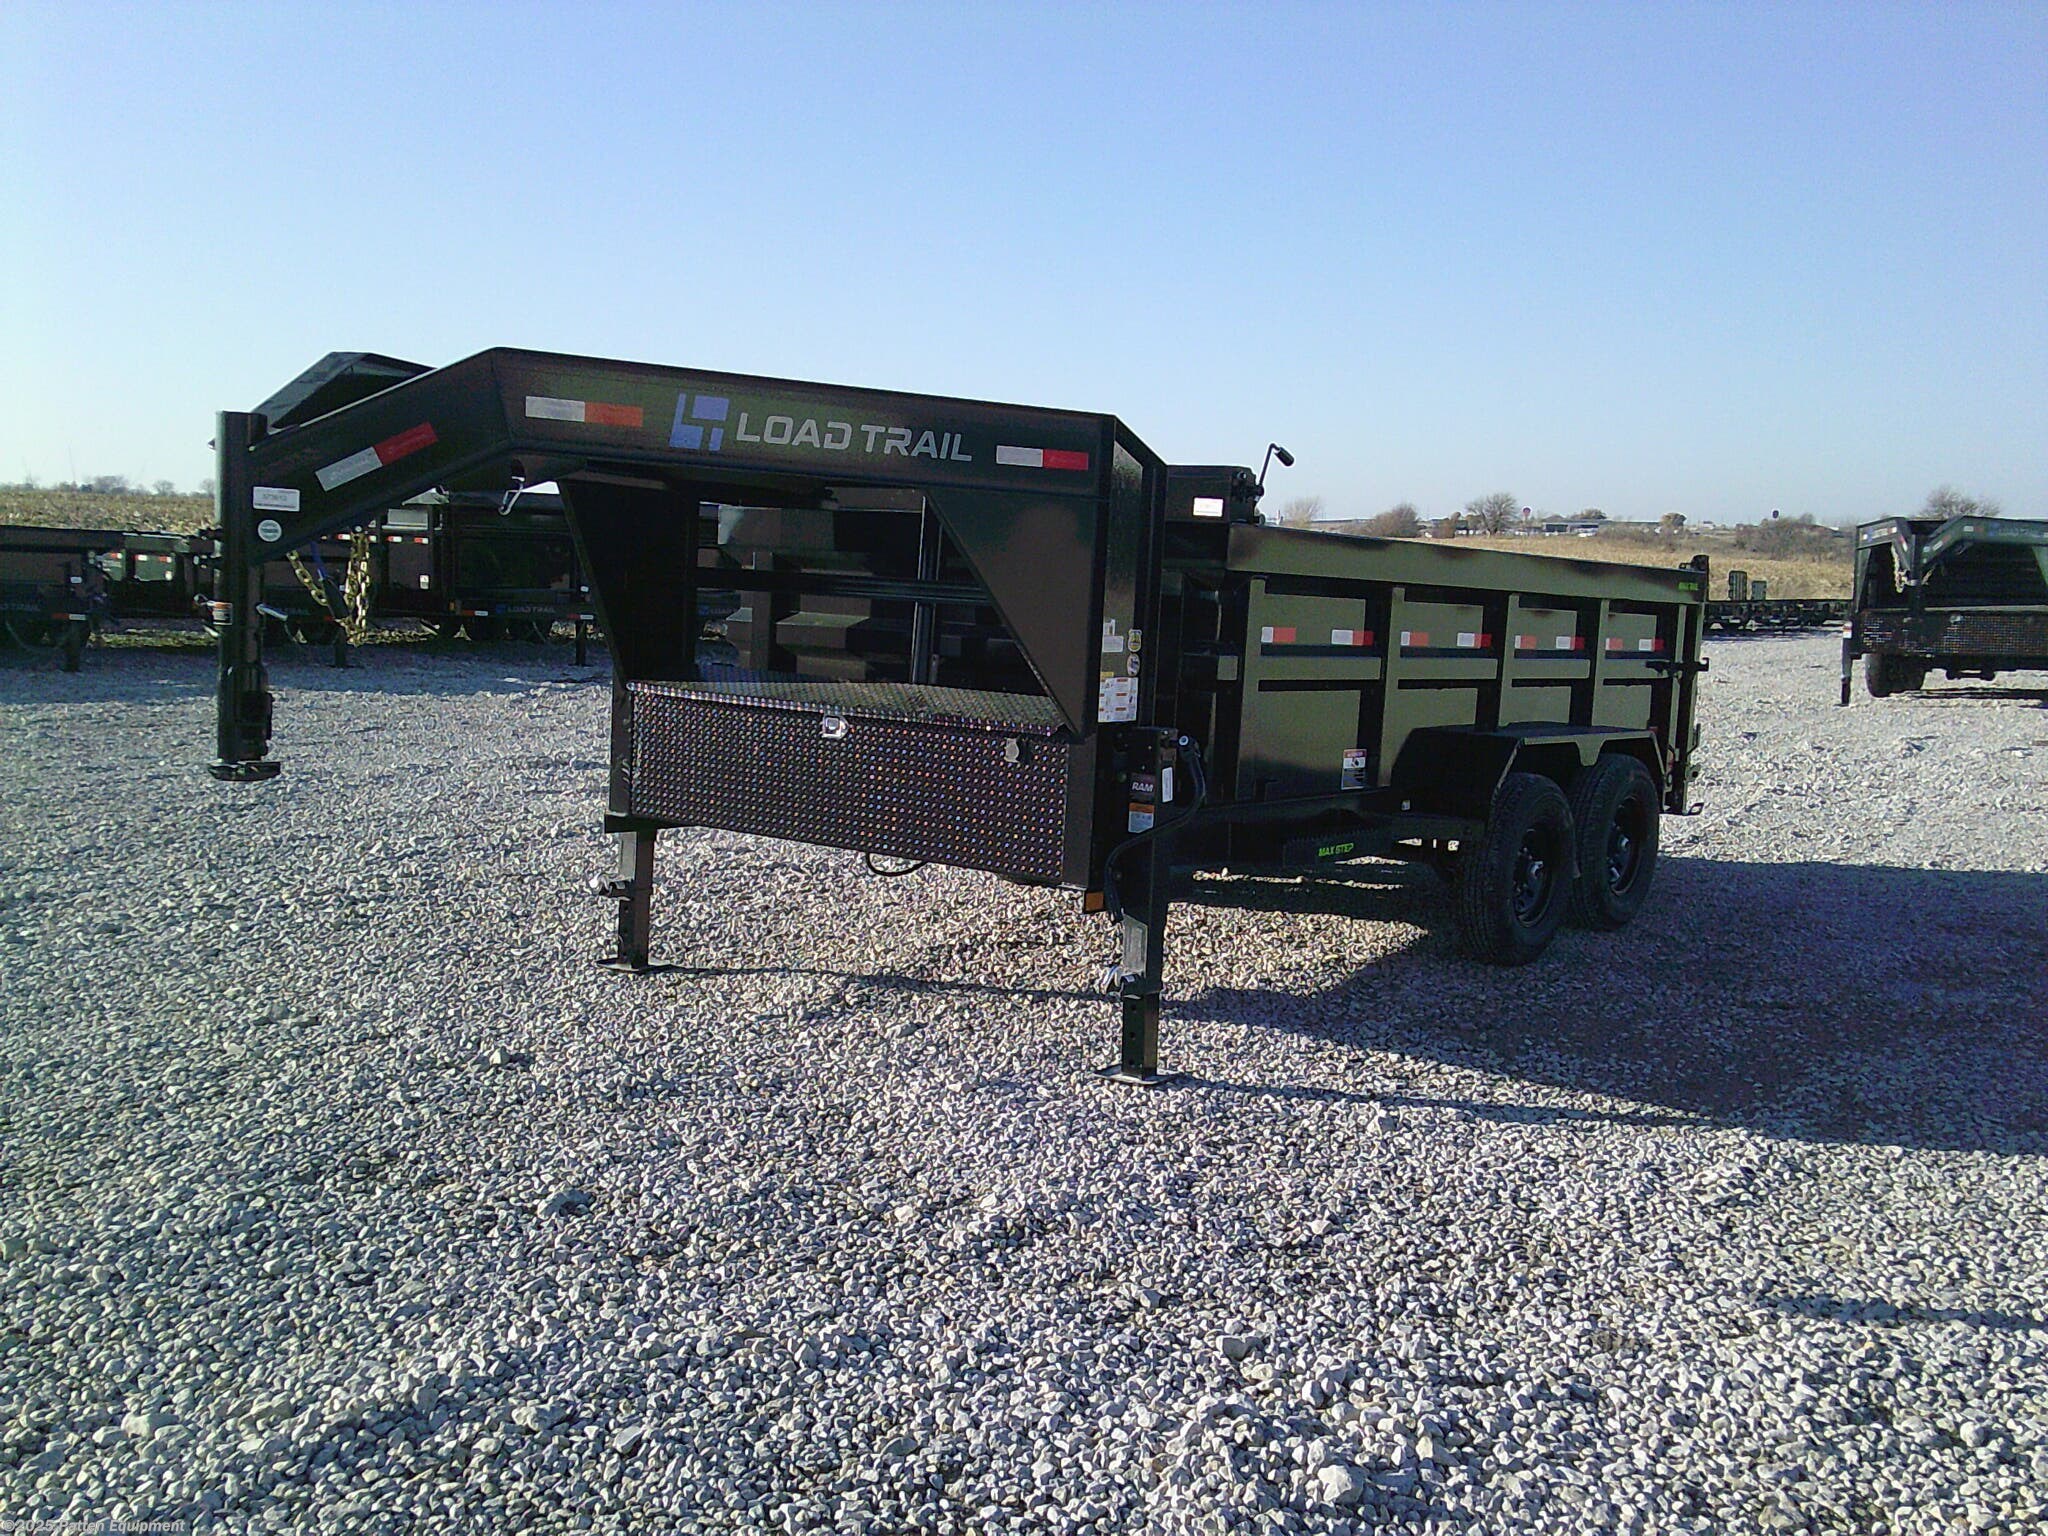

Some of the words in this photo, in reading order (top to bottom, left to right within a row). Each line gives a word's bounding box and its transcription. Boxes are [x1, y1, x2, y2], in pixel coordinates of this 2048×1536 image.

[736, 412, 853, 450] LOAD
[860, 424, 973, 462] TRAIL
[1131, 782, 1154, 792] RAM
